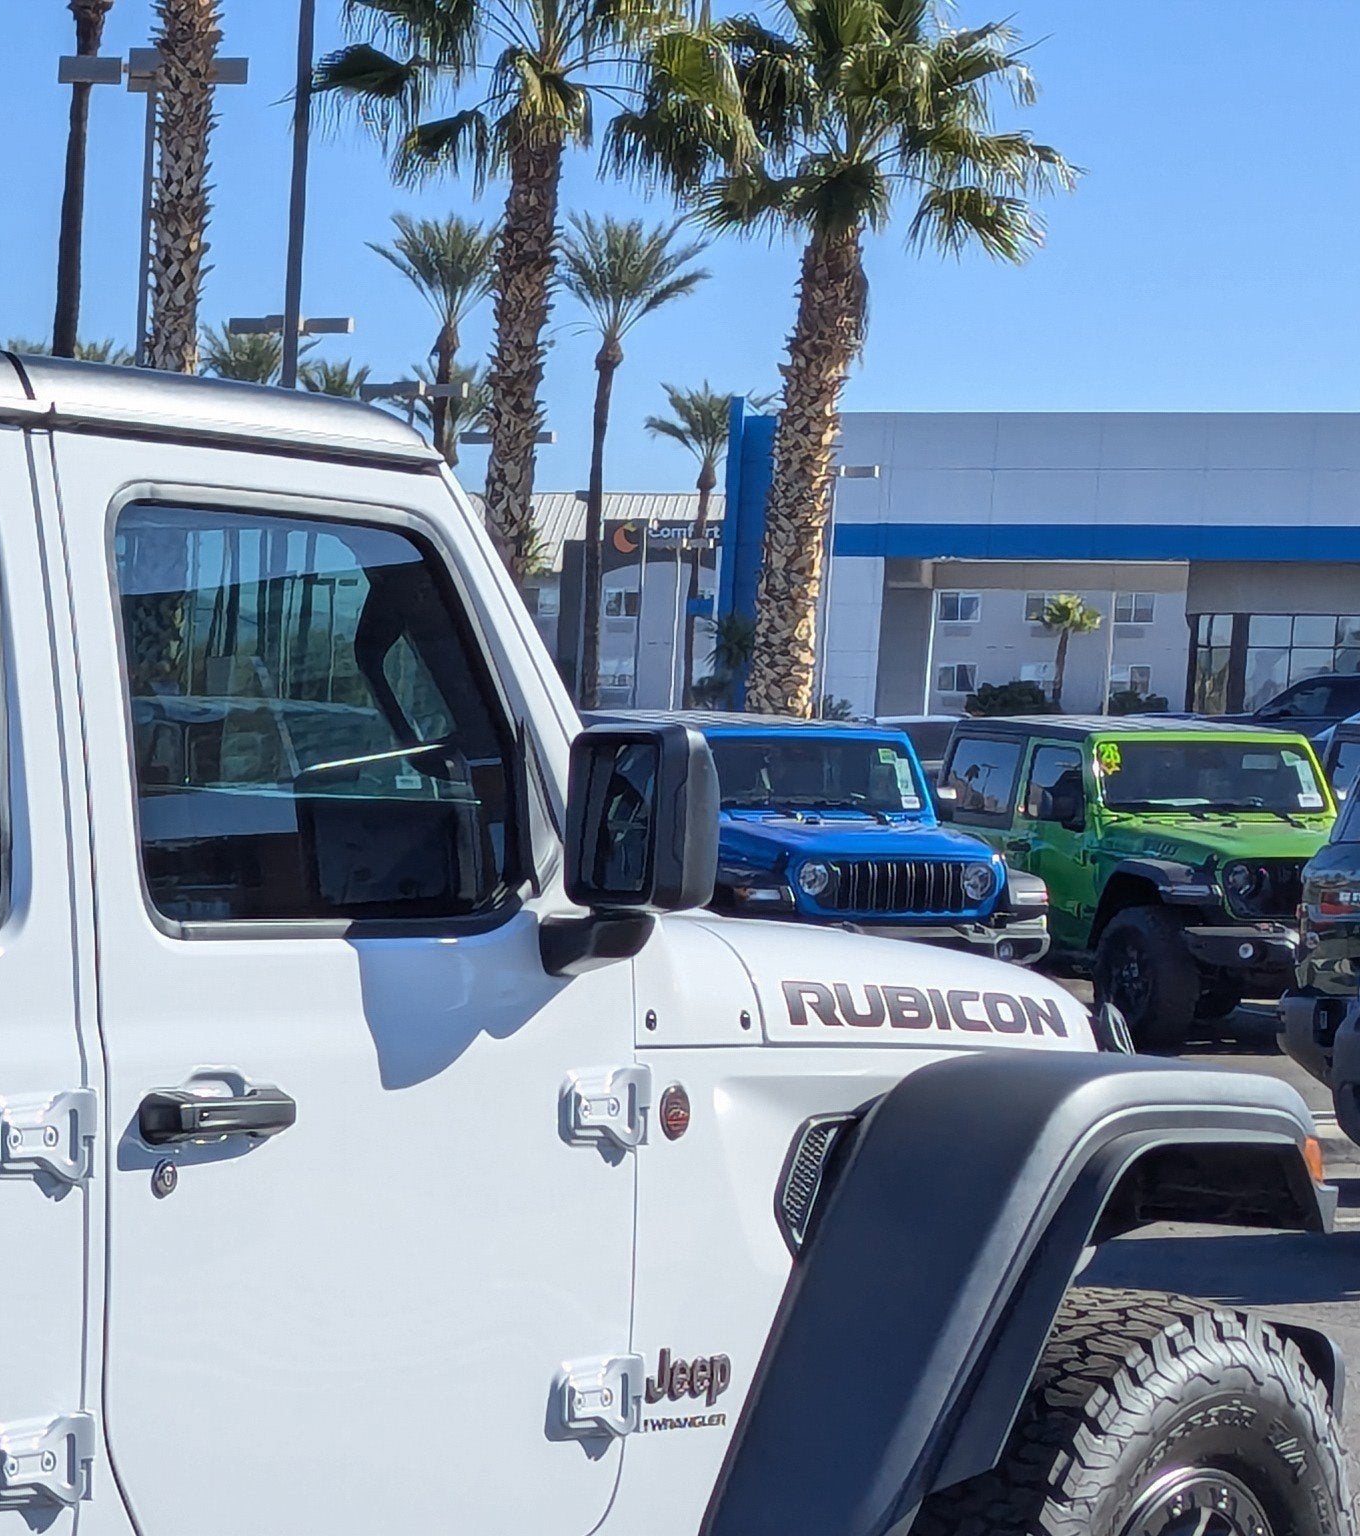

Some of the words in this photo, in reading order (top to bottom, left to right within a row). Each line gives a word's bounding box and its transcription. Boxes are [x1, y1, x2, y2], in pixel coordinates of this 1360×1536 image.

[648, 521, 720, 538] Comfrt
[781, 980, 1069, 1038] RUBICON
[644, 1347, 731, 1408] Jeep
